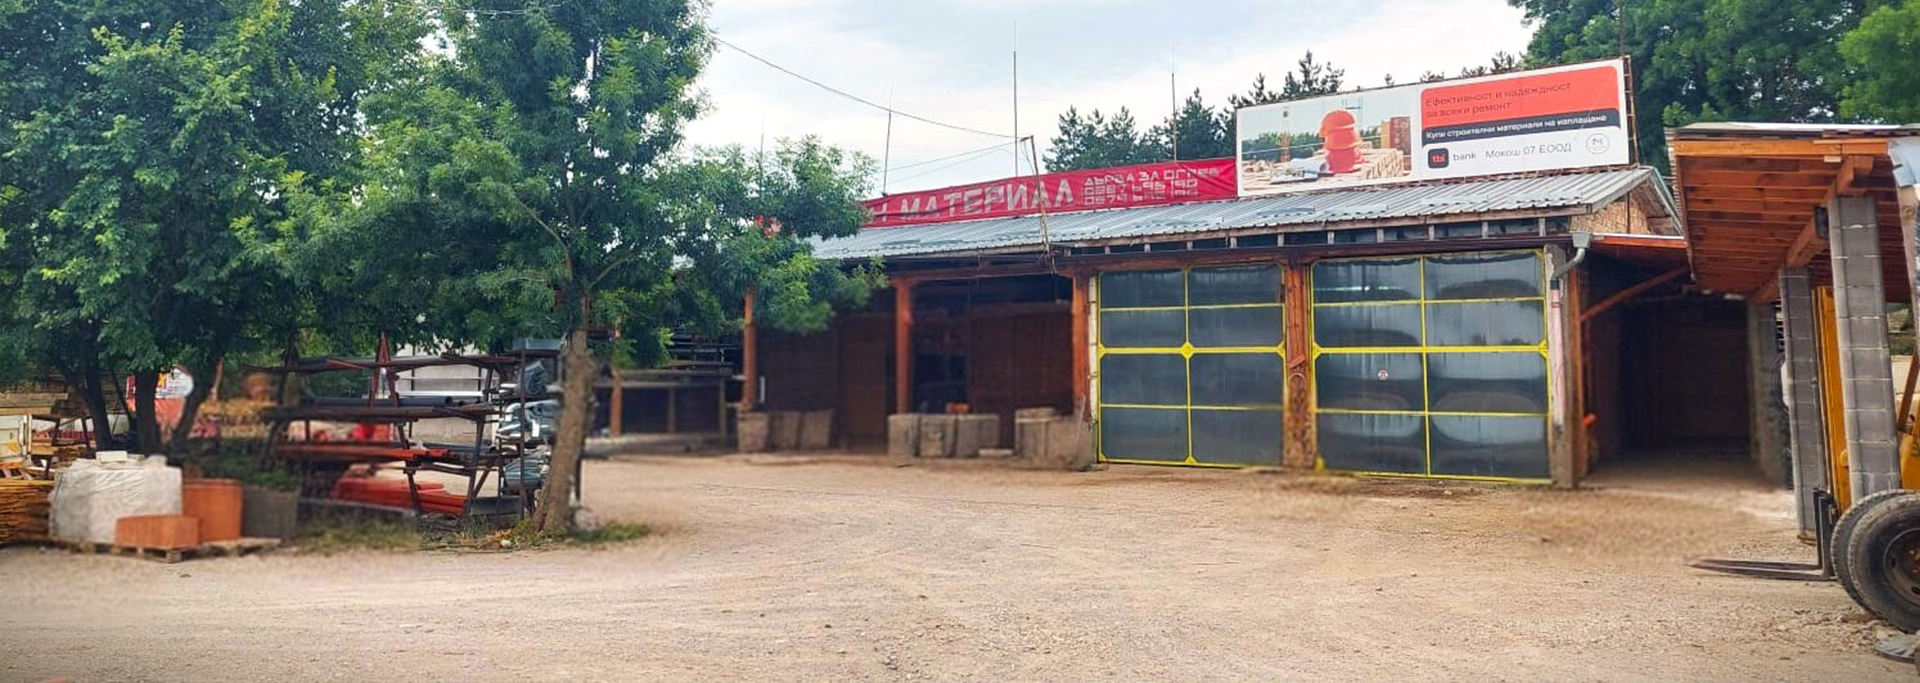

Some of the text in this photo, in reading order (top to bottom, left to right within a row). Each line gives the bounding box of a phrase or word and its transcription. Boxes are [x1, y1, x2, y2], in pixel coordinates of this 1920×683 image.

[1426, 93, 1492, 107] Ефективност
[1472, 102, 1512, 114] ремонт
[1426, 131, 1446, 140] Купи
[1447, 126, 1496, 137] строителни
[1497, 121, 1543, 132] материали
[1557, 114, 1607, 126] изплащане
[1523, 146, 1536, 155] 07
[1539, 143, 1572, 154] ЕООД
[1432, 151, 1477, 163] tbi bank
